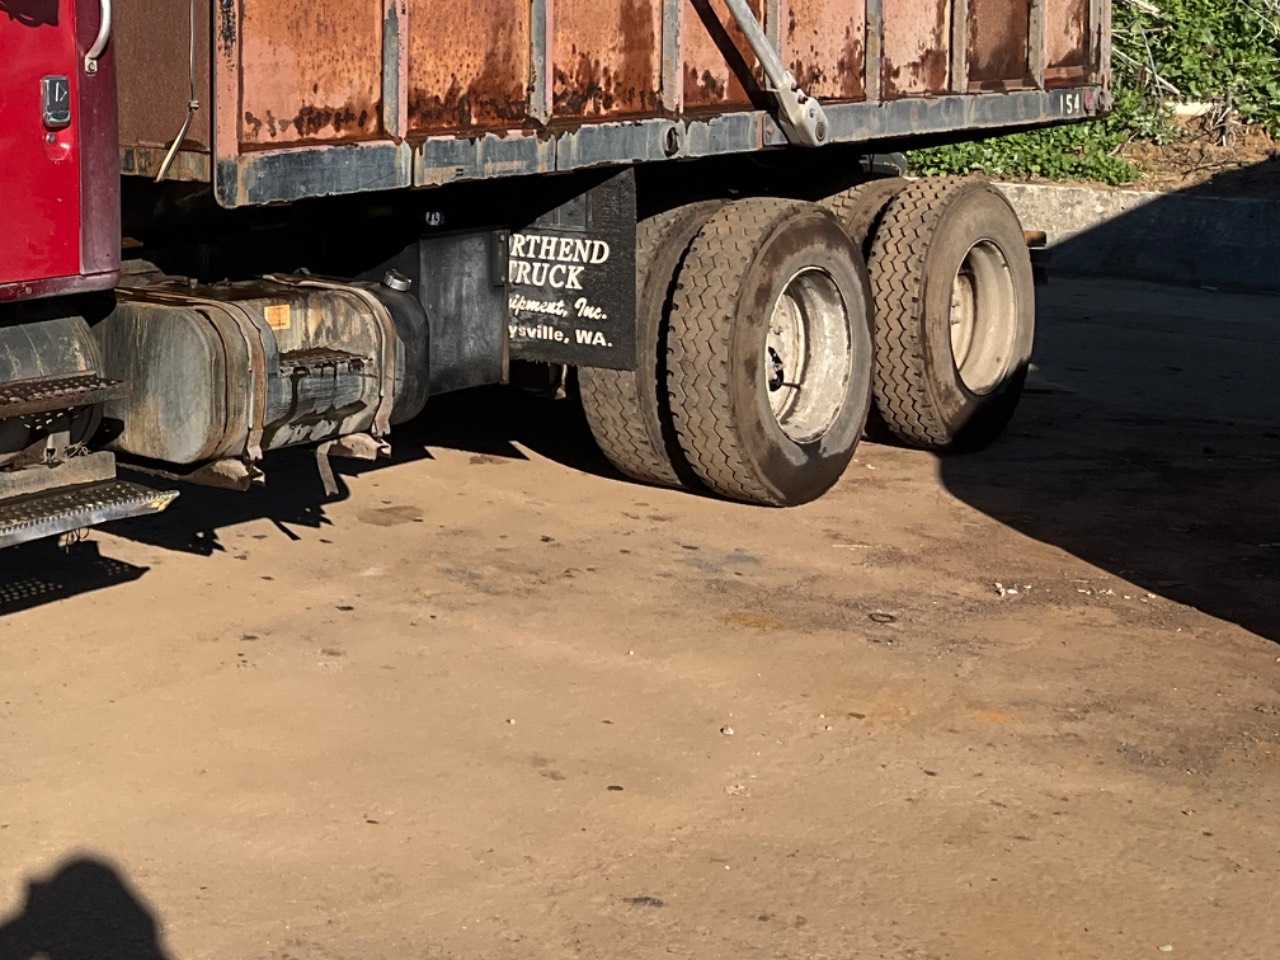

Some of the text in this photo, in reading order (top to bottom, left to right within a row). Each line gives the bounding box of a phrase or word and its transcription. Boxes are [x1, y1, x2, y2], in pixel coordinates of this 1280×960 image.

[1060, 93, 1080, 115] 154
[574, 297, 608, 320] Inc.
[575, 329, 613, 347] WA.
